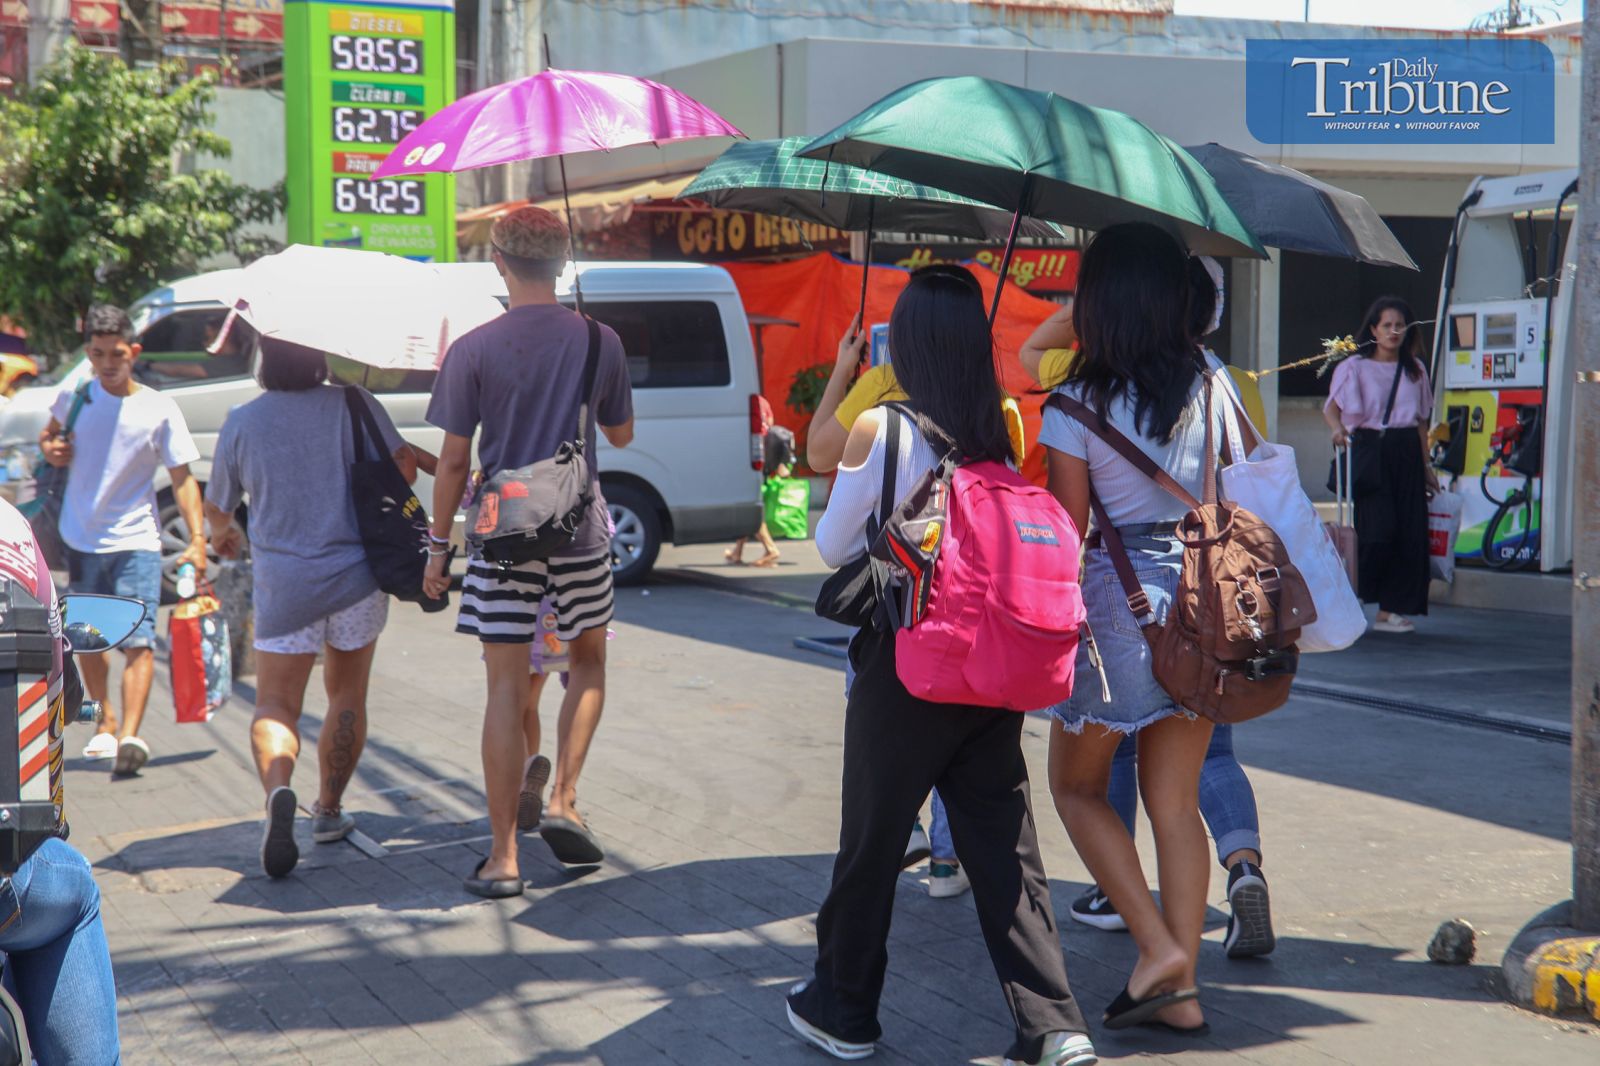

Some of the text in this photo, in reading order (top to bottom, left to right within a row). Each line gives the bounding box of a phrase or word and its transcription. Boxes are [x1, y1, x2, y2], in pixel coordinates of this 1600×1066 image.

[333, 36, 418, 74] 58.55
[336, 178, 421, 214] 64.25
[1527, 327, 1535, 344] 5
